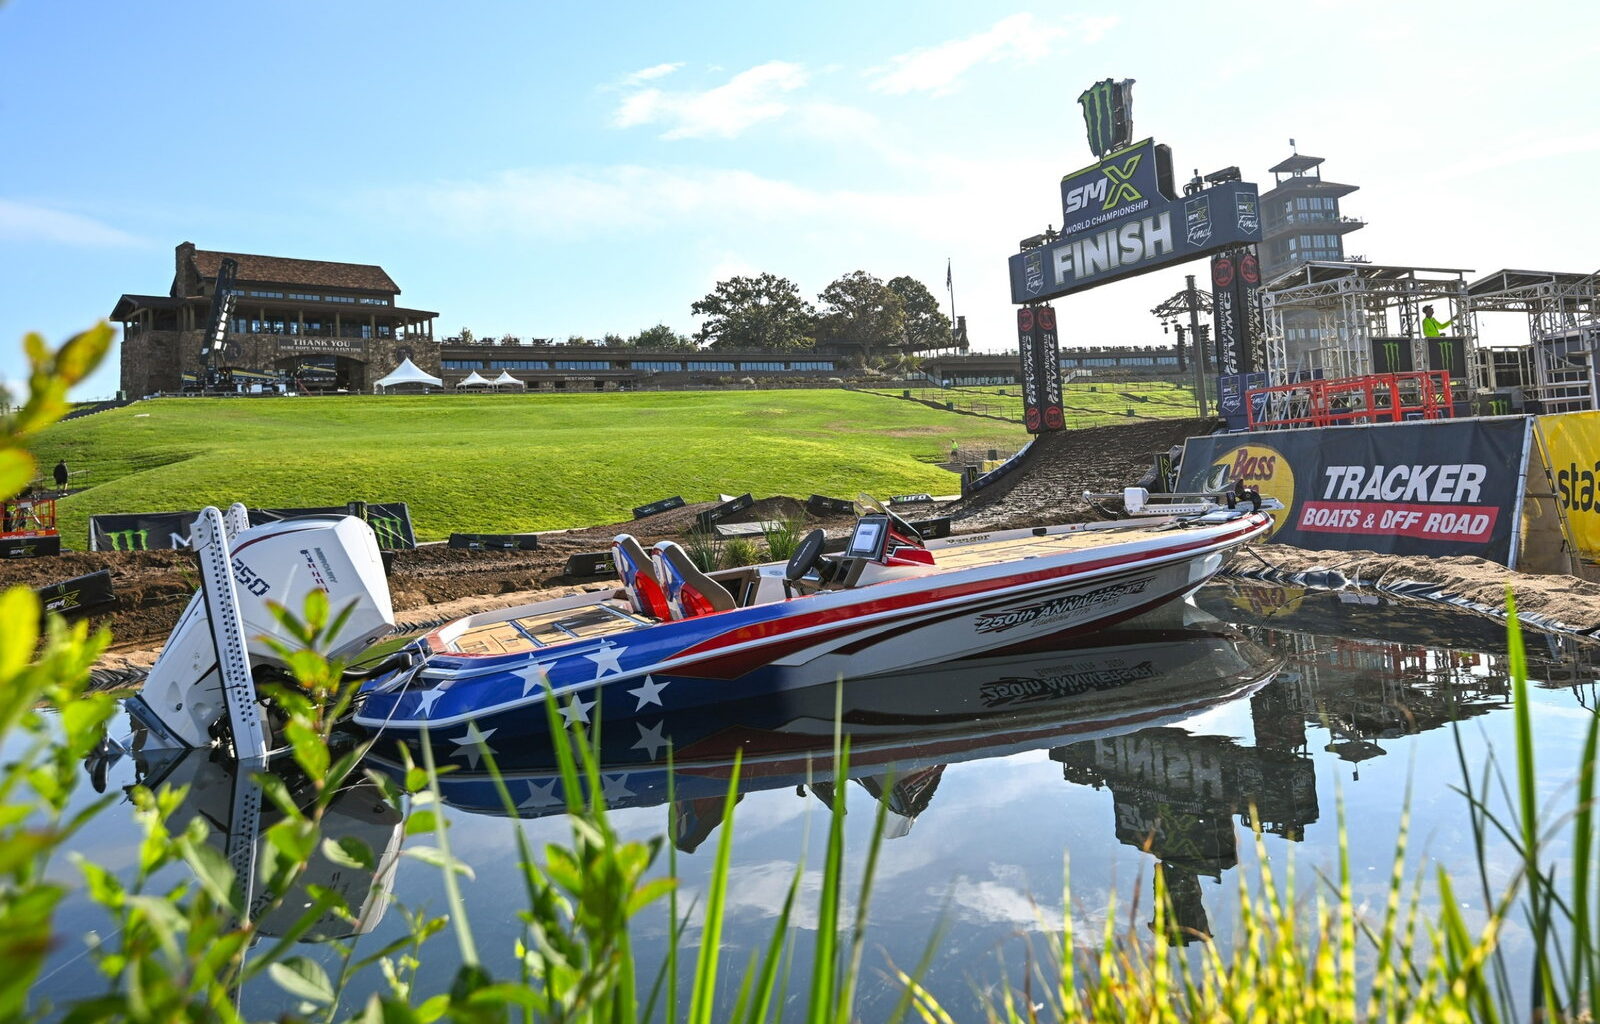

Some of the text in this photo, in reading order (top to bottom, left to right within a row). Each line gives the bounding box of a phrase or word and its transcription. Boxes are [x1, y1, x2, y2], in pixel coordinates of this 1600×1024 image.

[1065, 153, 1142, 214] SMX
[1066, 200, 1149, 234] WORLD CHAMPIONSHIP
[1052, 211, 1174, 286] FINISH
[1230, 449, 1276, 480] Bass
[1323, 464, 1487, 503] TRACKER
[1303, 508, 1490, 535] BOATS & OFF ROAD
[977, 610, 1035, 631] 250th
[1038, 580, 1151, 618] ANNIVERSARY
